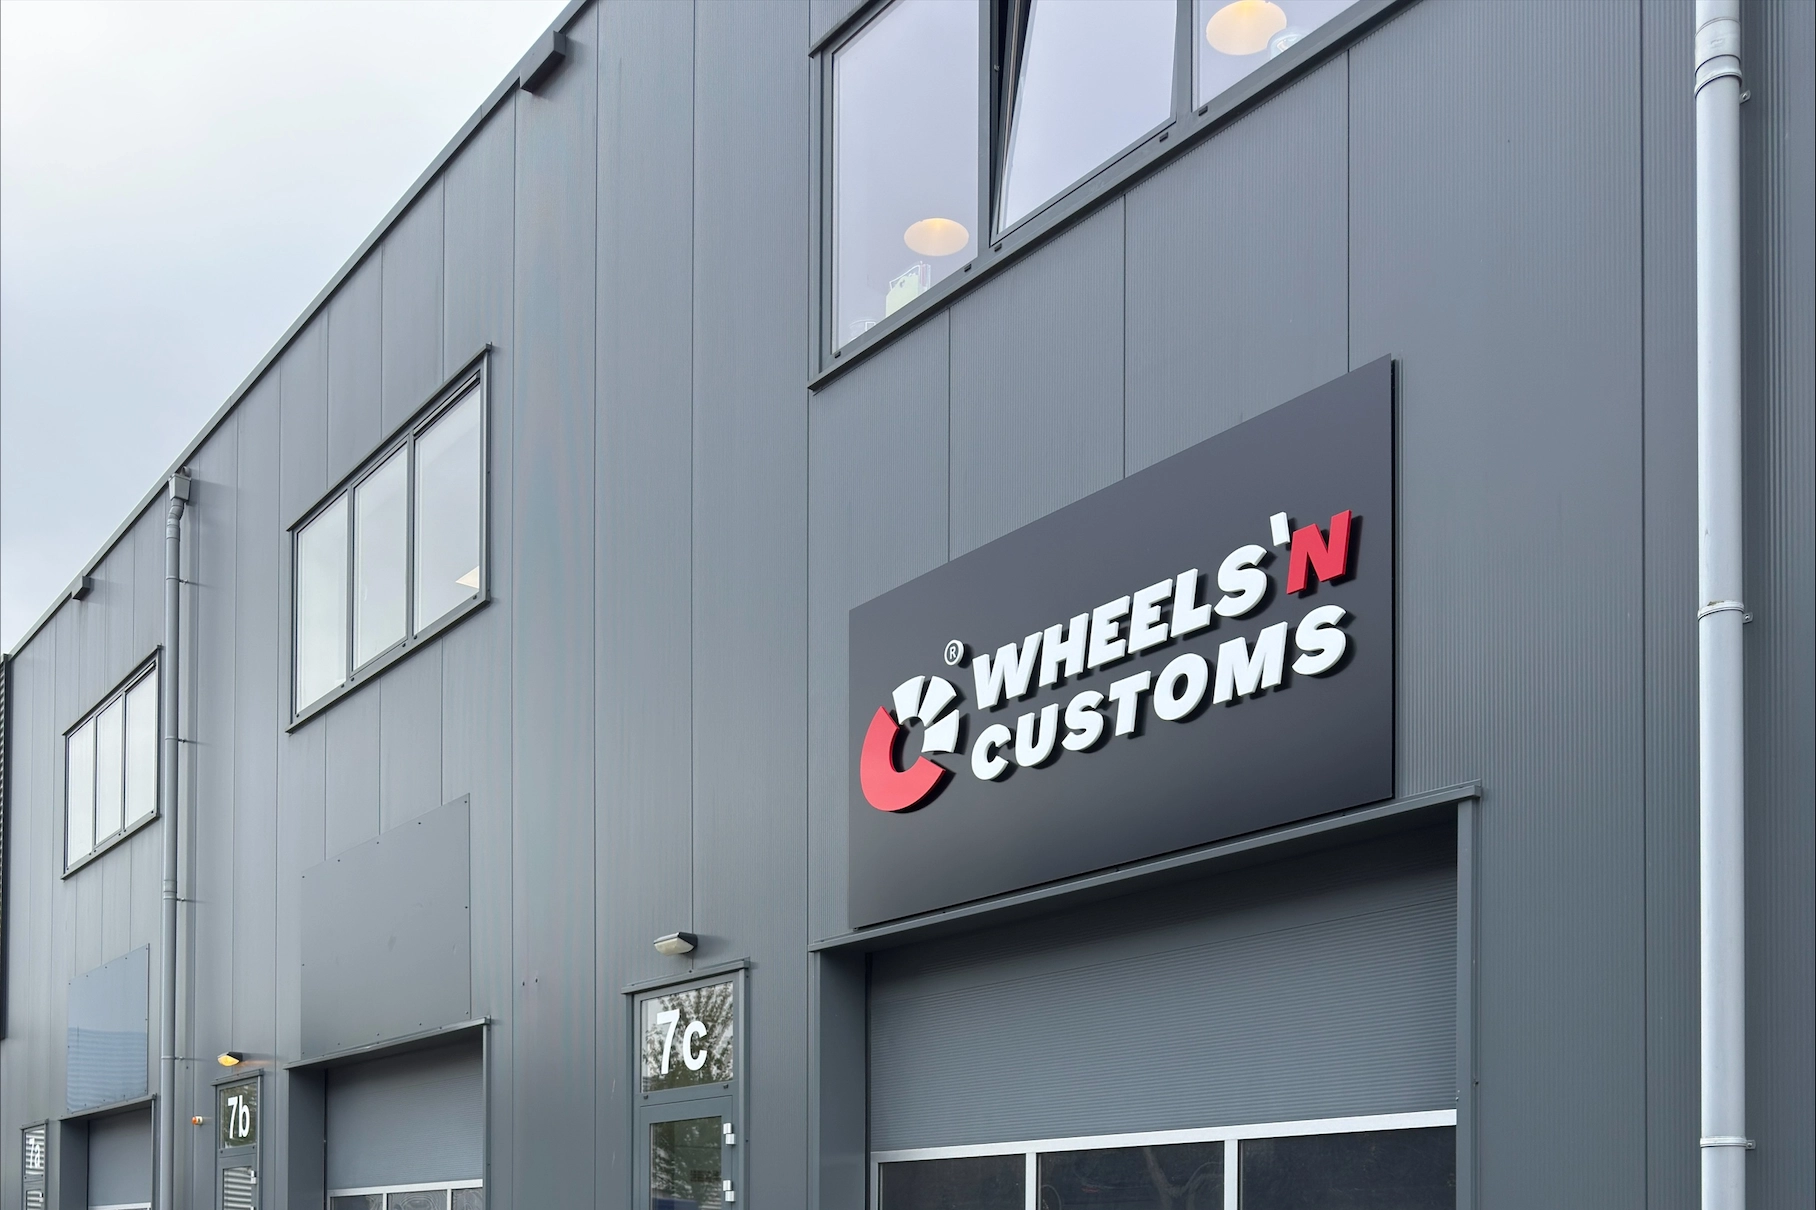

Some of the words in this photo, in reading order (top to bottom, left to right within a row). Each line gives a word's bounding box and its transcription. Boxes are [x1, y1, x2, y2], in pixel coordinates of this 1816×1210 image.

[971, 605, 1347, 781] CUSTOMS
[657, 1008, 708, 1075] 7c
[228, 1095, 250, 1139] 7b
